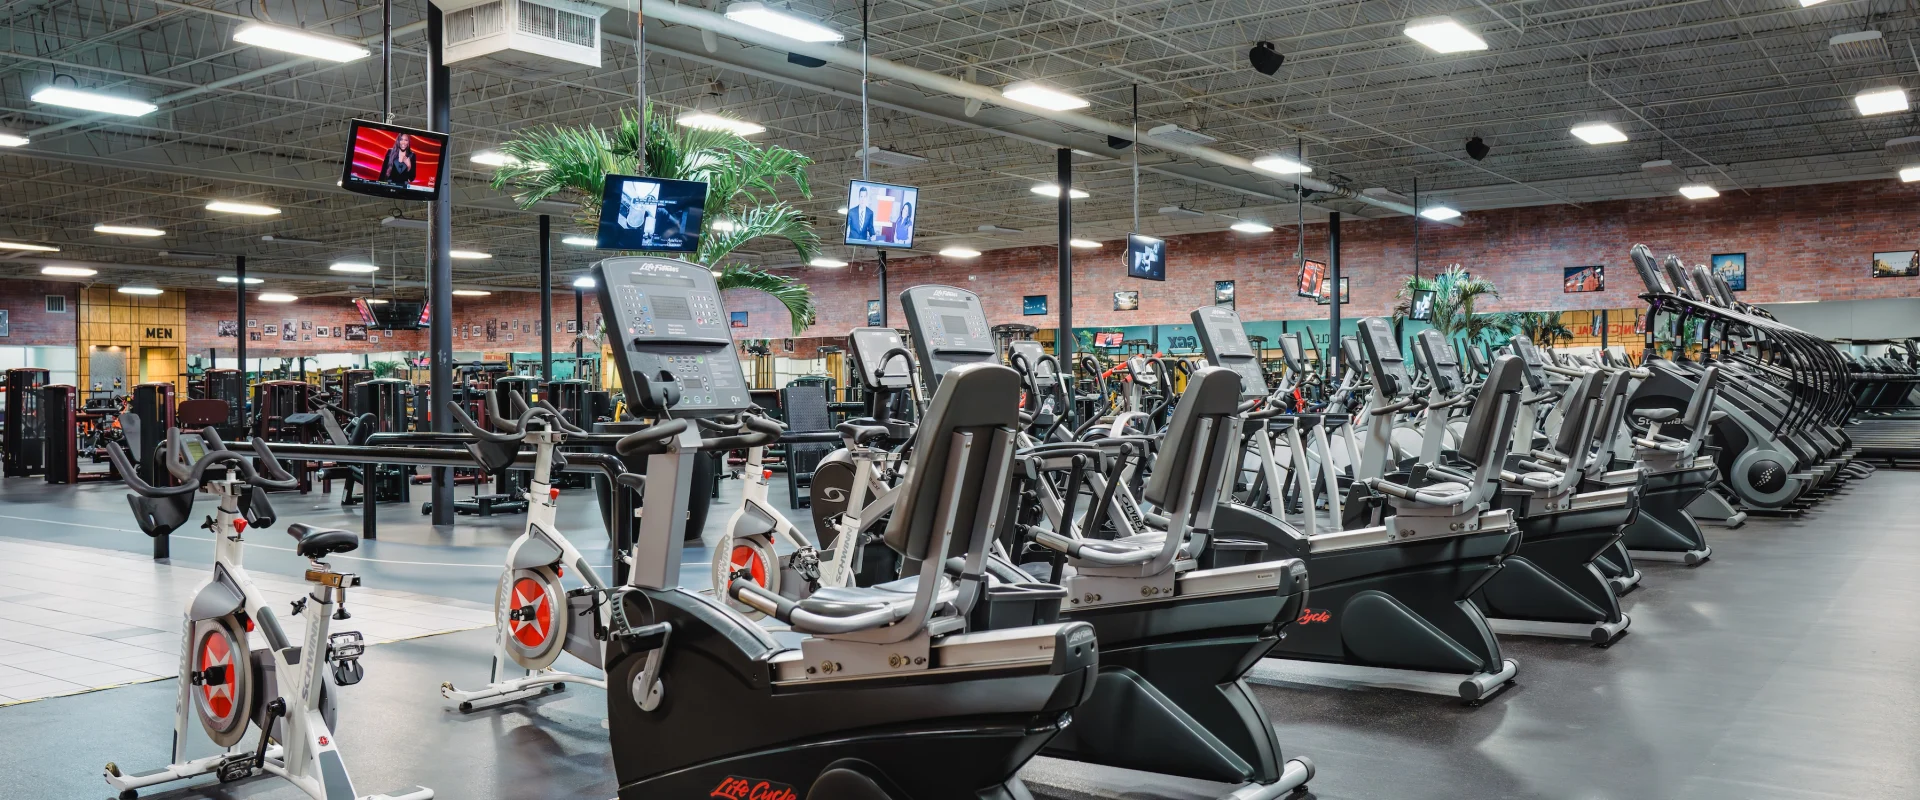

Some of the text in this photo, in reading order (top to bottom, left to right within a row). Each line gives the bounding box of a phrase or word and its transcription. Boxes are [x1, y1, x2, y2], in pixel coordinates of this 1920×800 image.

[146, 327, 172, 338] MEN
[1126, 505, 1145, 531] CYBEX
[835, 527, 852, 583] SCHWINN
[496, 564, 511, 645] SCHWINN
[176, 612, 190, 715] SCHWINN
[302, 614, 320, 700] SCHWINN
[710, 777, 798, 800] Life Cycle
